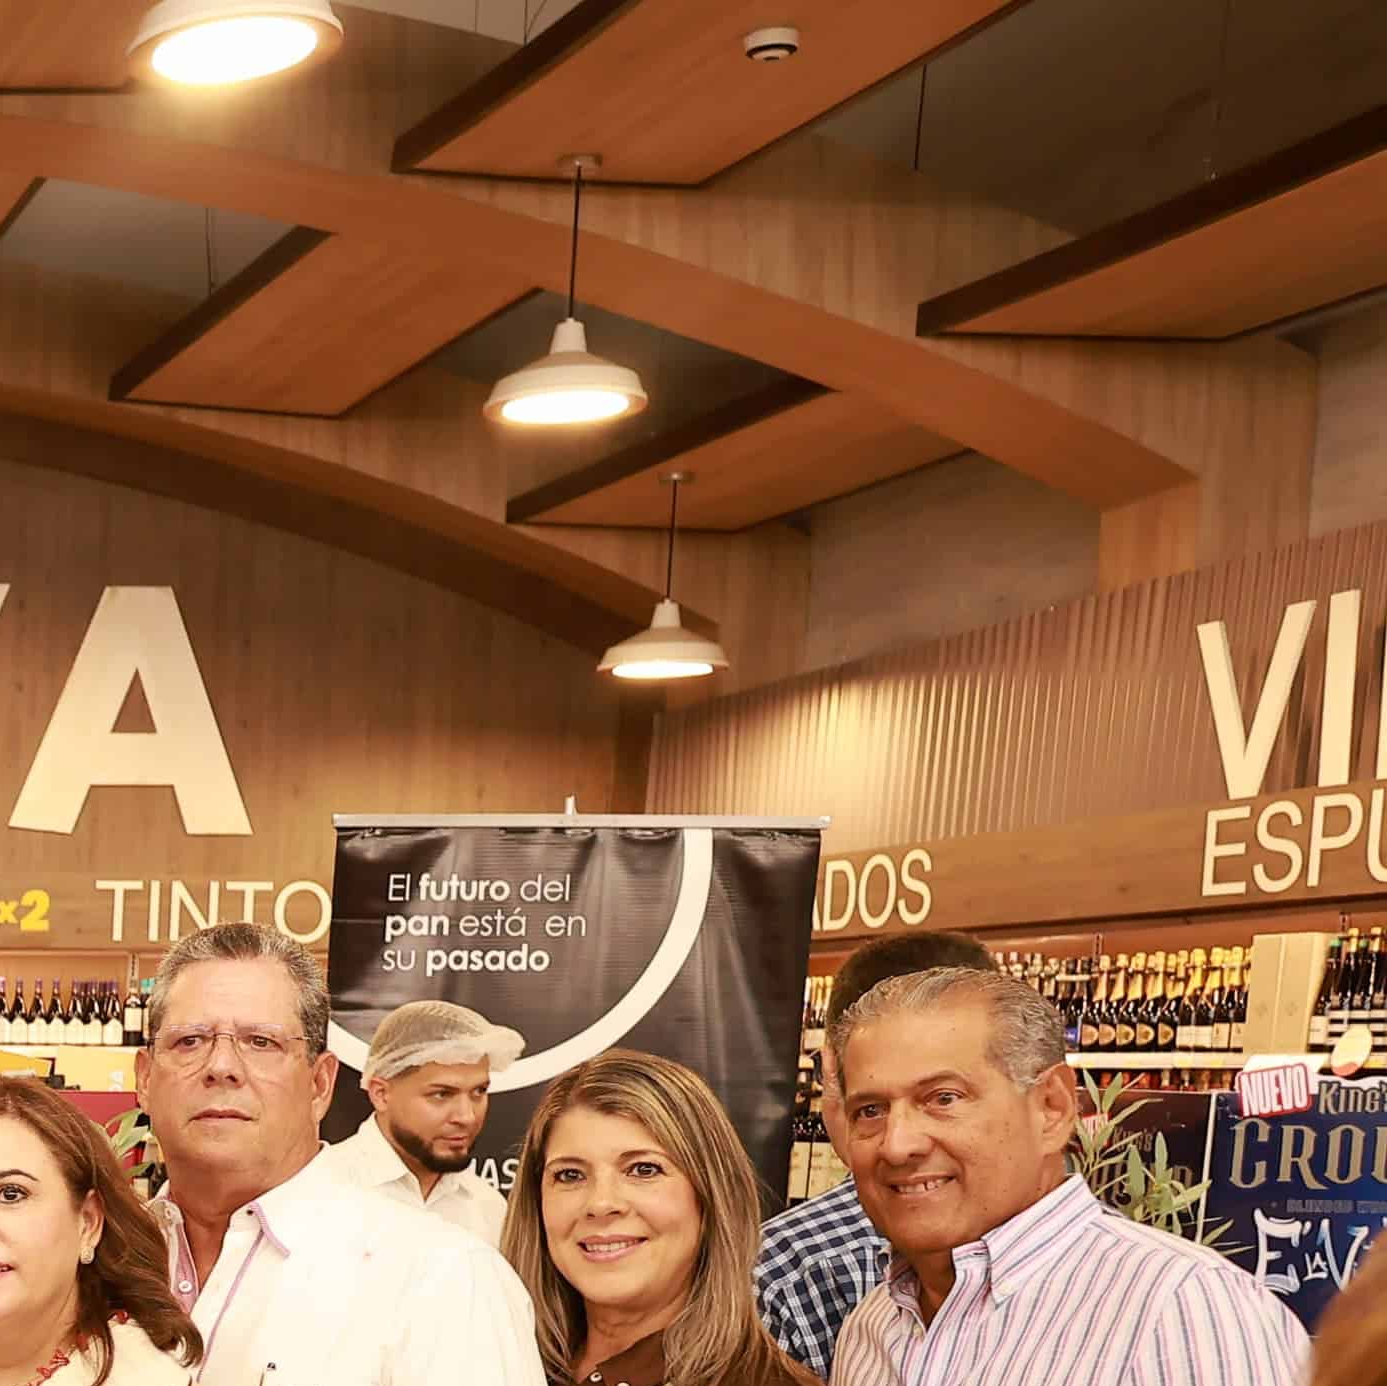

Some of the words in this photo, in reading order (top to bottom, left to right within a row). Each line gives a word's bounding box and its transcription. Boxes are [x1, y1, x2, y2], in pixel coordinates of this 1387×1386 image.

[1196, 588, 1387, 800] VI
[388, 873, 411, 901] El
[419, 873, 511, 901] futuro
[520, 873, 571, 901] del
[812, 848, 932, 932] DOS
[95, 880, 332, 944] TINTO
[384, 914, 450, 943] pan
[458, 907, 527, 936] está
[544, 914, 587, 936] en
[382, 949, 416, 971] su
[426, 943, 550, 977] pasado
[1240, 1064, 1309, 1118] NUEVO
[468, 1157, 521, 1190] AS
